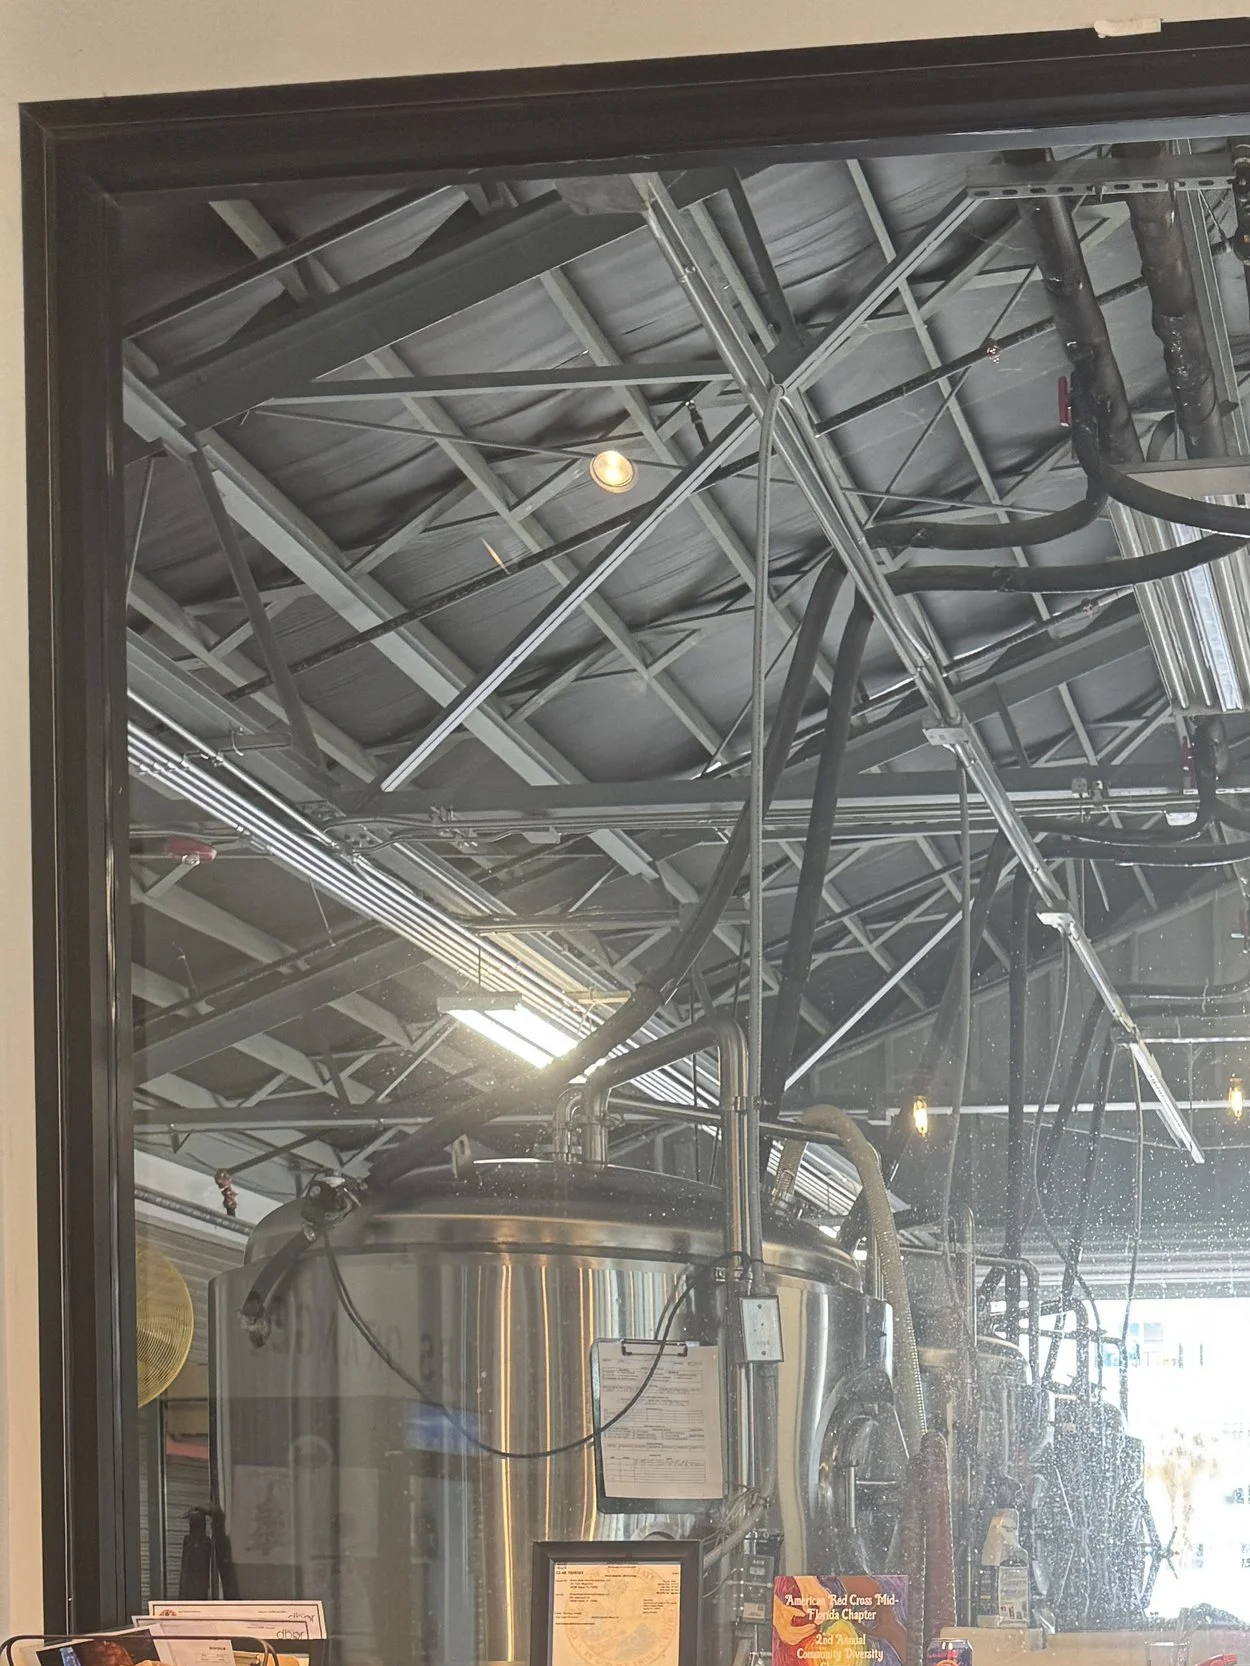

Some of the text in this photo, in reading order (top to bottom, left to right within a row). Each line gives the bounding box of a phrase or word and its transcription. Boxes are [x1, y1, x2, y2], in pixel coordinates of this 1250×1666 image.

[785, 1593, 899, 1606] American Red Cross Mid-
[807, 1608, 877, 1623] Florida Chapter
[815, 1633, 866, 1645] 2nd Annual
[796, 1648, 884, 1663] Community Diversity
